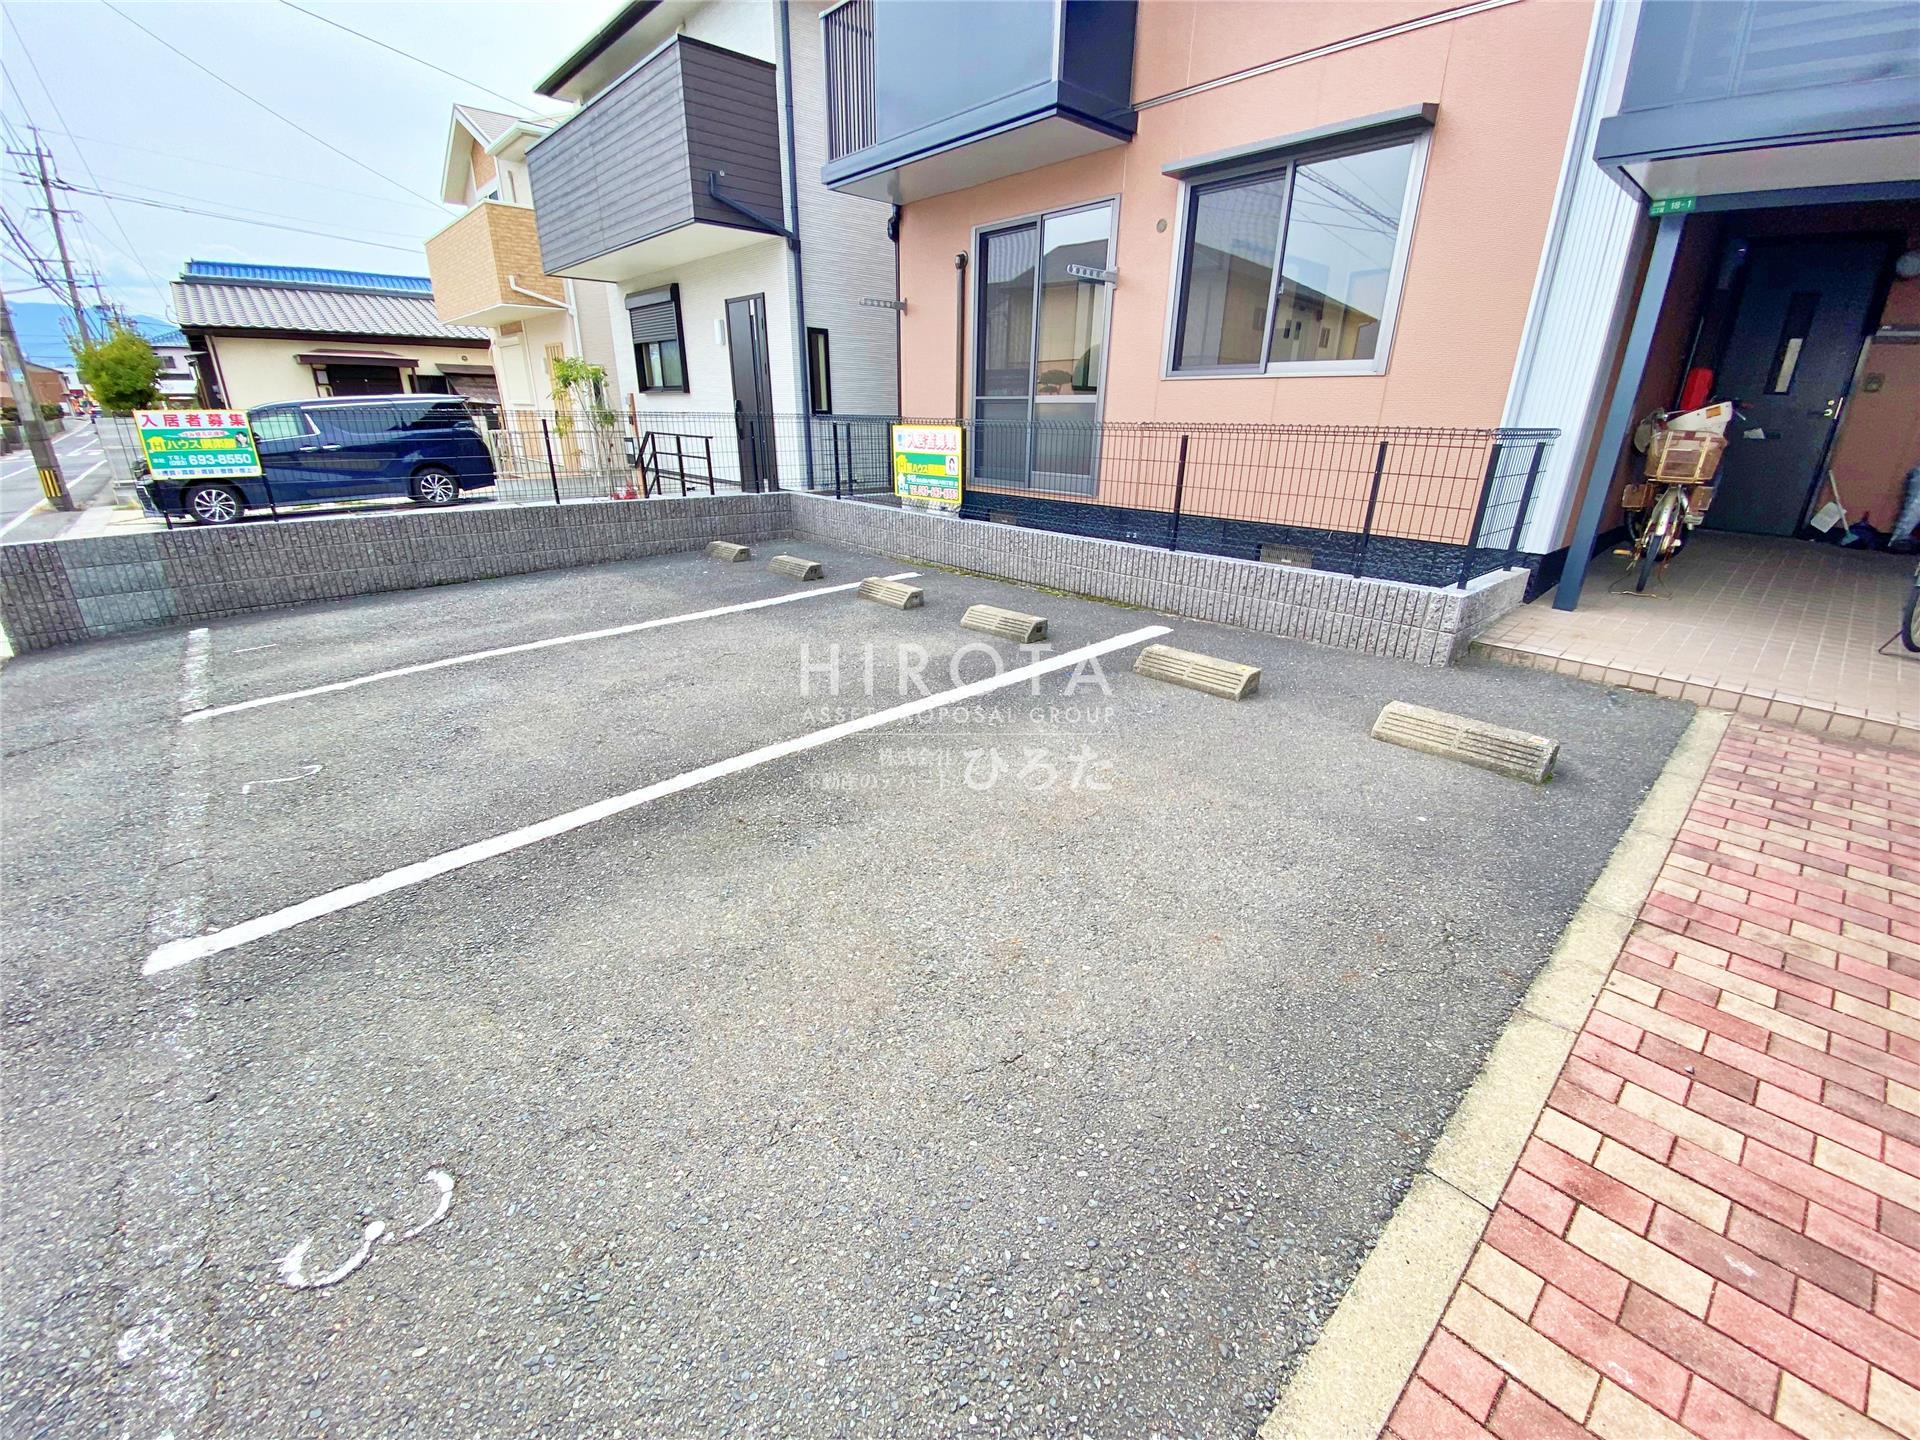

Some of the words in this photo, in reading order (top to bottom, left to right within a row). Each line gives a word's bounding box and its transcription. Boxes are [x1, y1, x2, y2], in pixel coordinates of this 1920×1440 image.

[141, 414, 246, 428] 入居者募集
[188, 453, 252, 466] 693-8550
